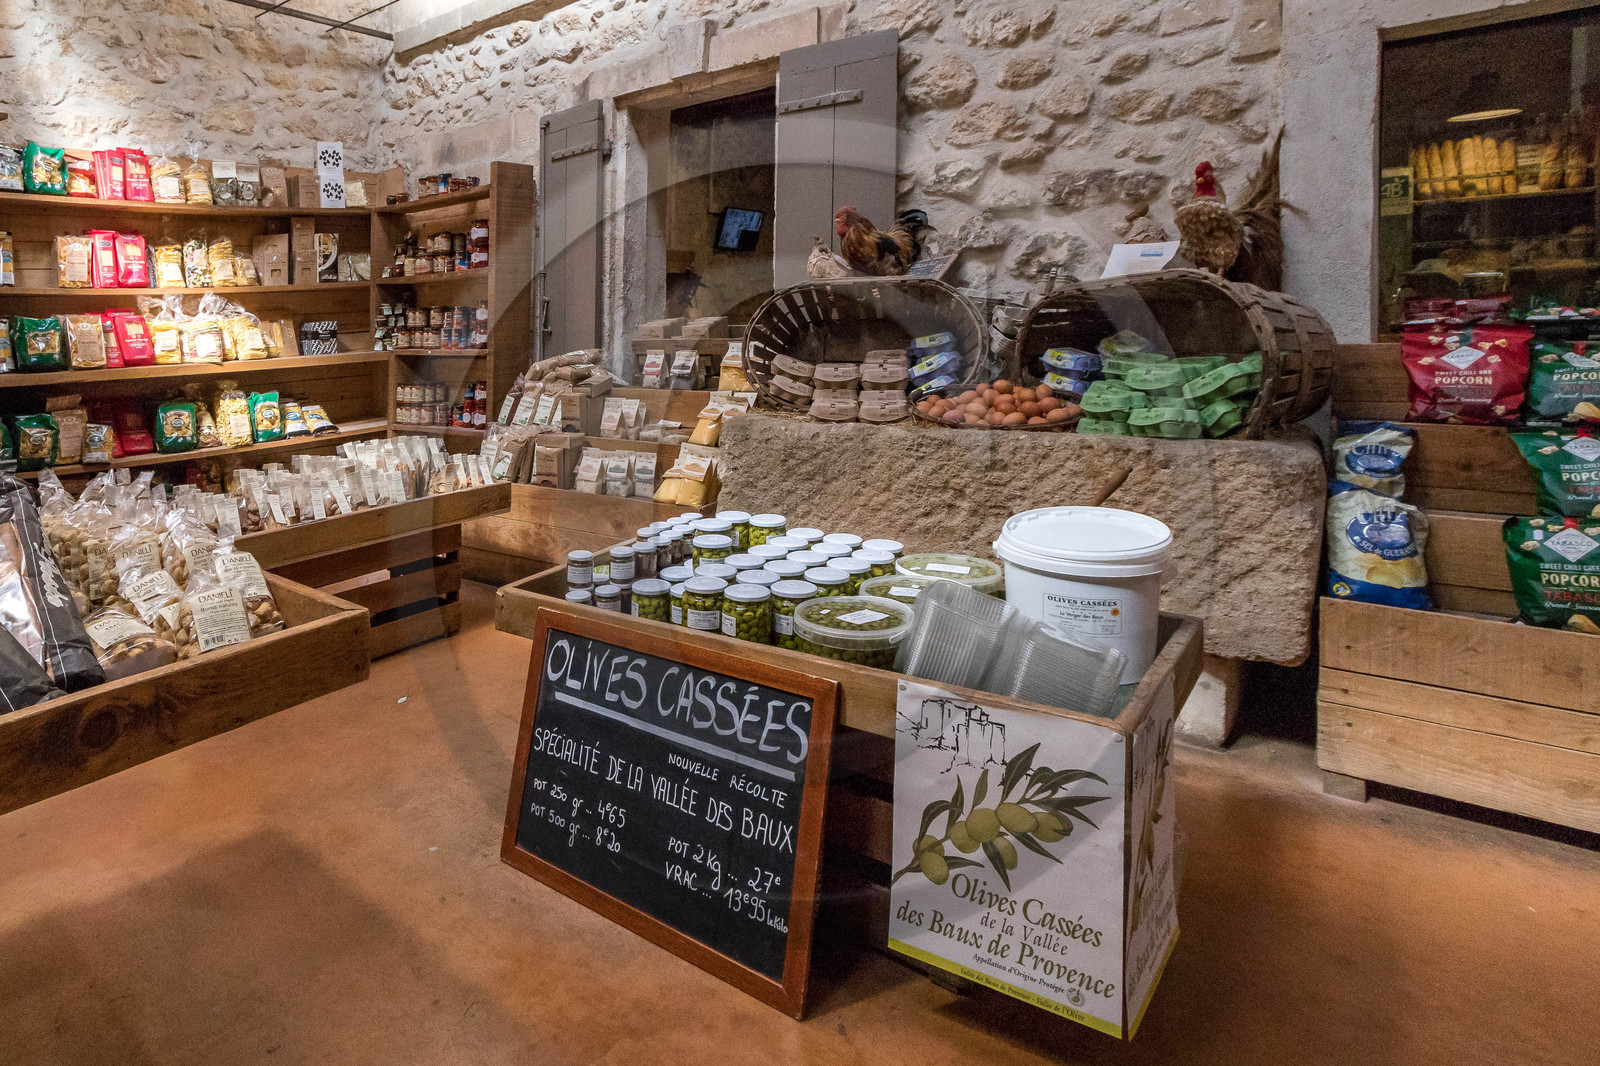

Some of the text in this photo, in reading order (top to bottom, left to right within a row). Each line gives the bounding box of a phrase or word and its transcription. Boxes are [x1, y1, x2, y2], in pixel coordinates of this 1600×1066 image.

[1434, 376, 1493, 386] POPCORN
[1553, 371, 1600, 382] POPCO
[1561, 471, 1600, 482] POPC
[1550, 540, 1594, 548] TABASCO
[198, 588, 233, 604] DANIELI
[1047, 595, 1118, 608] OLIVES CASSÉES
[657, 666, 811, 764] CASSÉES
[533, 778, 548, 791] POT
[550, 784, 567, 802] 250
[668, 753, 788, 808] NOUVELLE RÉCOLTE
[531, 802, 546, 818] POT
[548, 809, 566, 828] 500
[605, 755, 627, 785] DE
[627, 763, 644, 792] LA
[650, 778, 698, 816] VALLÉE
[705, 797, 733, 831] DES
[741, 807, 793, 854] BAUX
[668, 836, 690, 859] POT
[665, 861, 698, 891] VRAC
[952, 873, 1103, 948] Olives Cassées
[980, 912, 1068, 956] de la Vallée
[896, 900, 1116, 999] des Baux de Provence
[972, 953, 1066, 994] Appellation d'Origine Protégée
[960, 968, 975, 979] Vallée
[985, 977, 1000, 988] Baux
[1007, 987, 1031, 1000] Provence
[1036, 998, 1052, 1010] Vallée
[1054, 1004, 1060, 1012] de
[1062, 1006, 1085, 1022] l'Olive
